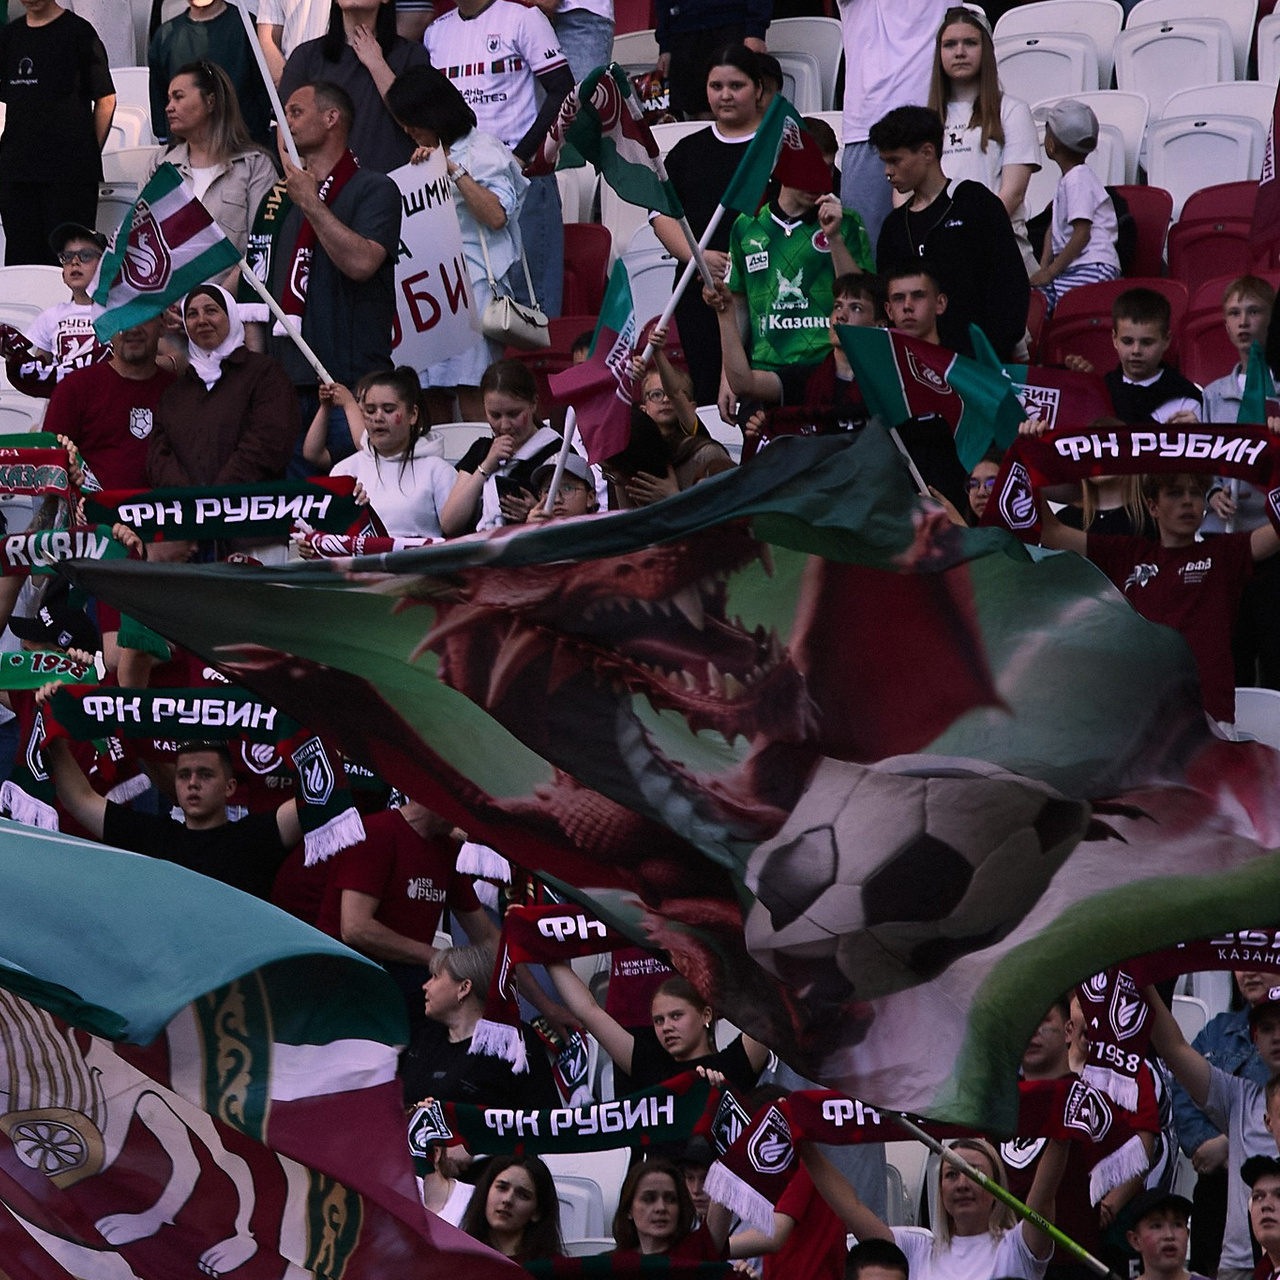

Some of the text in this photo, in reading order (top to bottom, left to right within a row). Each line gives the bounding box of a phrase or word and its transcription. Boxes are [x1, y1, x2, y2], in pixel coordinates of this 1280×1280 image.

[1055, 431, 1268, 465] ФК РУБИН
[117, 494, 333, 527] ФК РУБИН
[5, 531, 110, 567] RUBIN
[31, 652, 90, 681] 1958
[82, 695, 278, 731] ФК РУБИН
[343, 762, 375, 778] ЗАНЬ
[1094, 1040, 1140, 1073] 1958
[484, 1095, 675, 1137] ФК РУБИН
